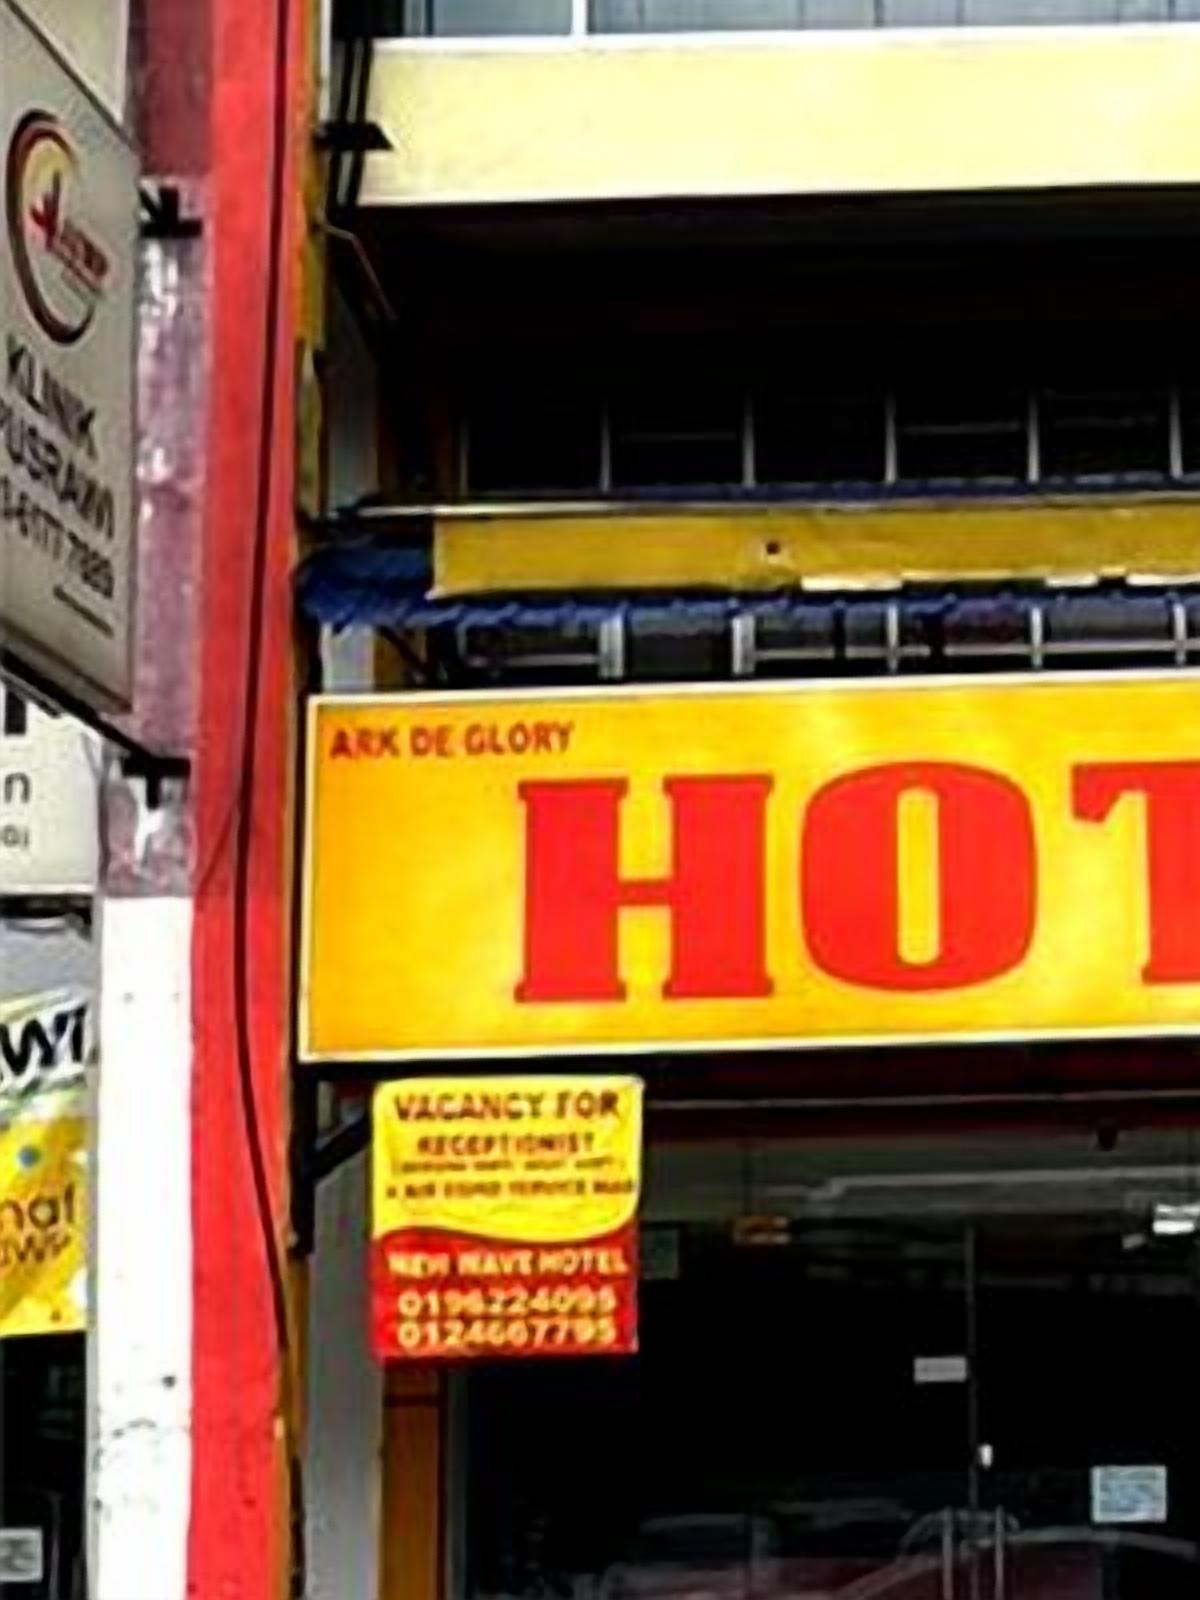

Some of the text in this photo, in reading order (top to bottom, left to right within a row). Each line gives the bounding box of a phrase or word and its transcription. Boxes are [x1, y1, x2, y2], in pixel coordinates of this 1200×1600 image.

[7, 333, 96, 460] KLINIK
[329, 720, 575, 760] ARK DE GLORY
[393, 1089, 621, 1120] VACANCY FOR
[417, 1132, 595, 1156] RECEPTIONIST
[539, 1246, 631, 1276] HOTEL
